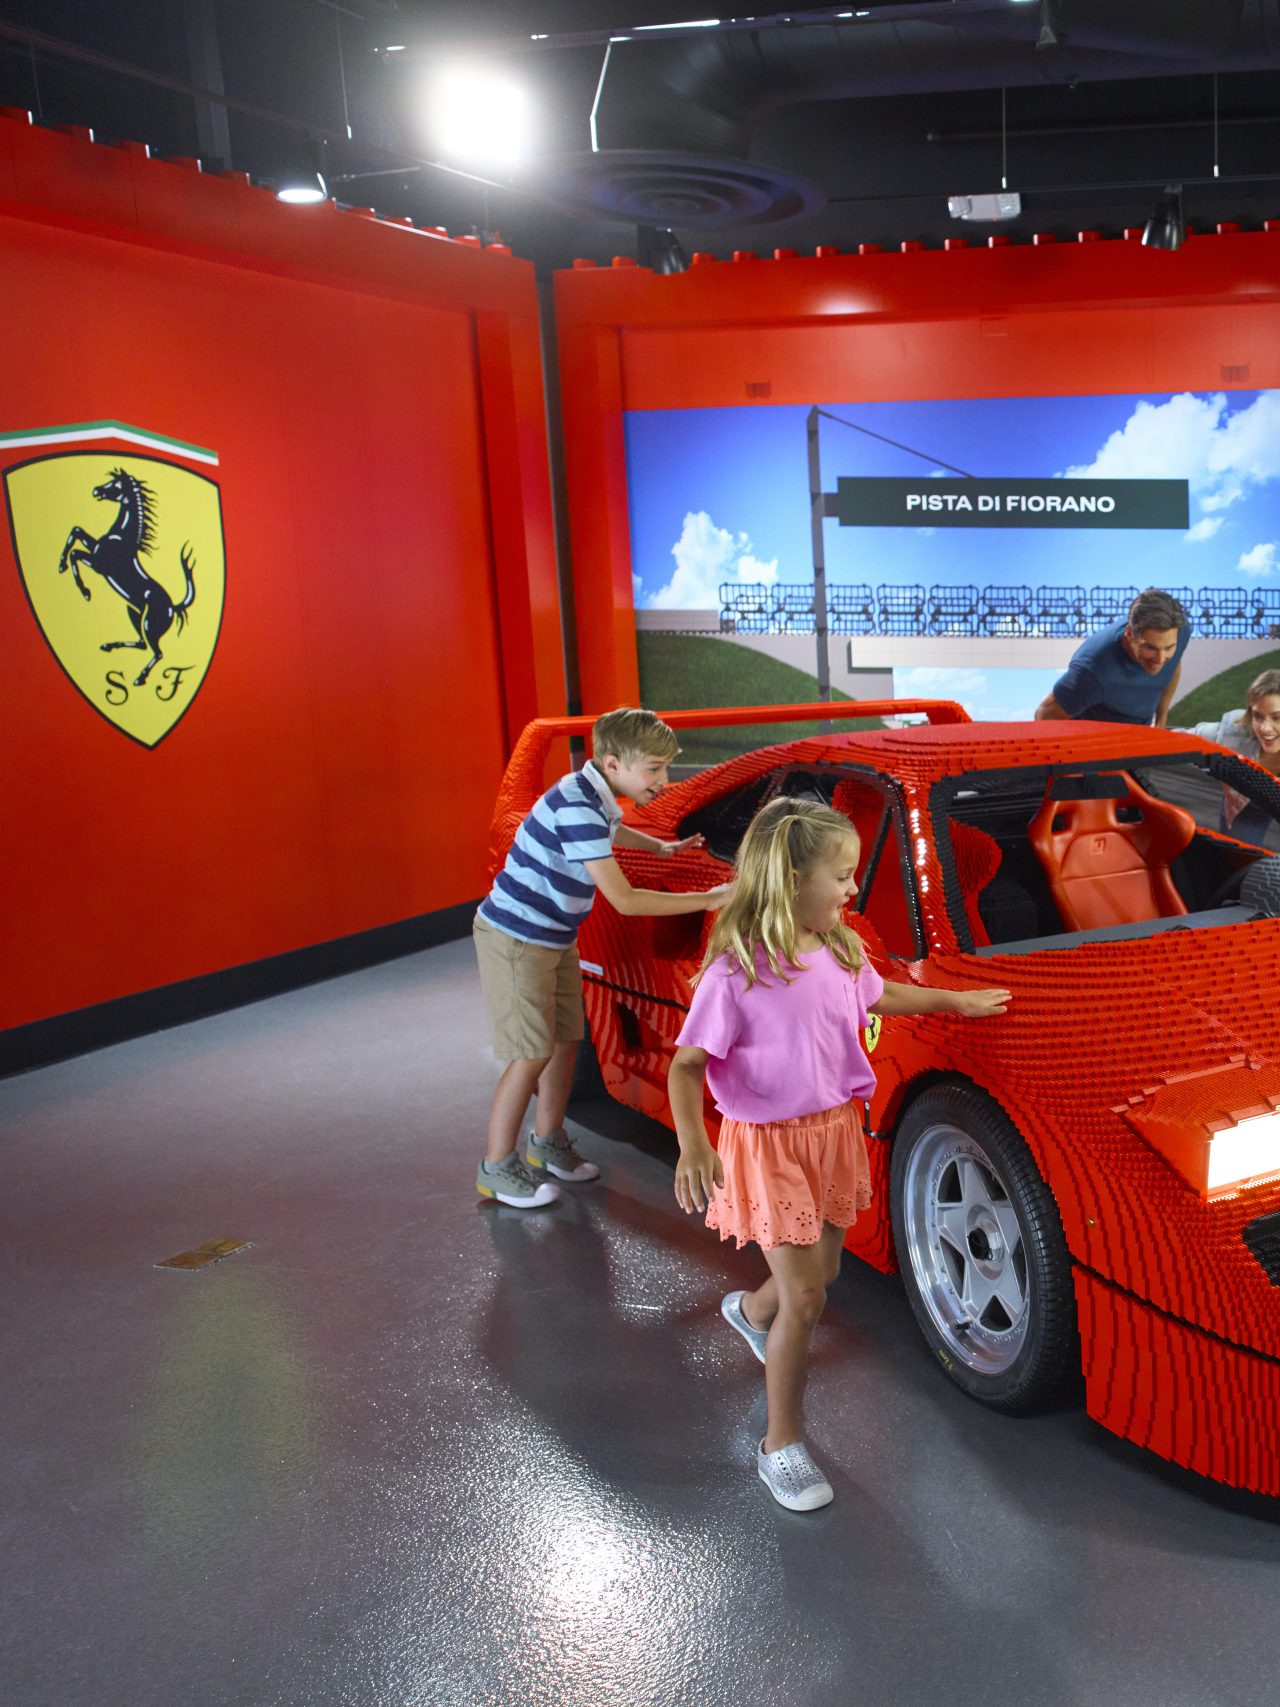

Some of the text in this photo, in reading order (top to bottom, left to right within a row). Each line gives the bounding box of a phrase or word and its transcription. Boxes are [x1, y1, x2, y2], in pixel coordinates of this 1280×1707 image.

[906, 494, 1116, 513] PISTA DI FIORANO
[105, 664, 197, 706] S F
